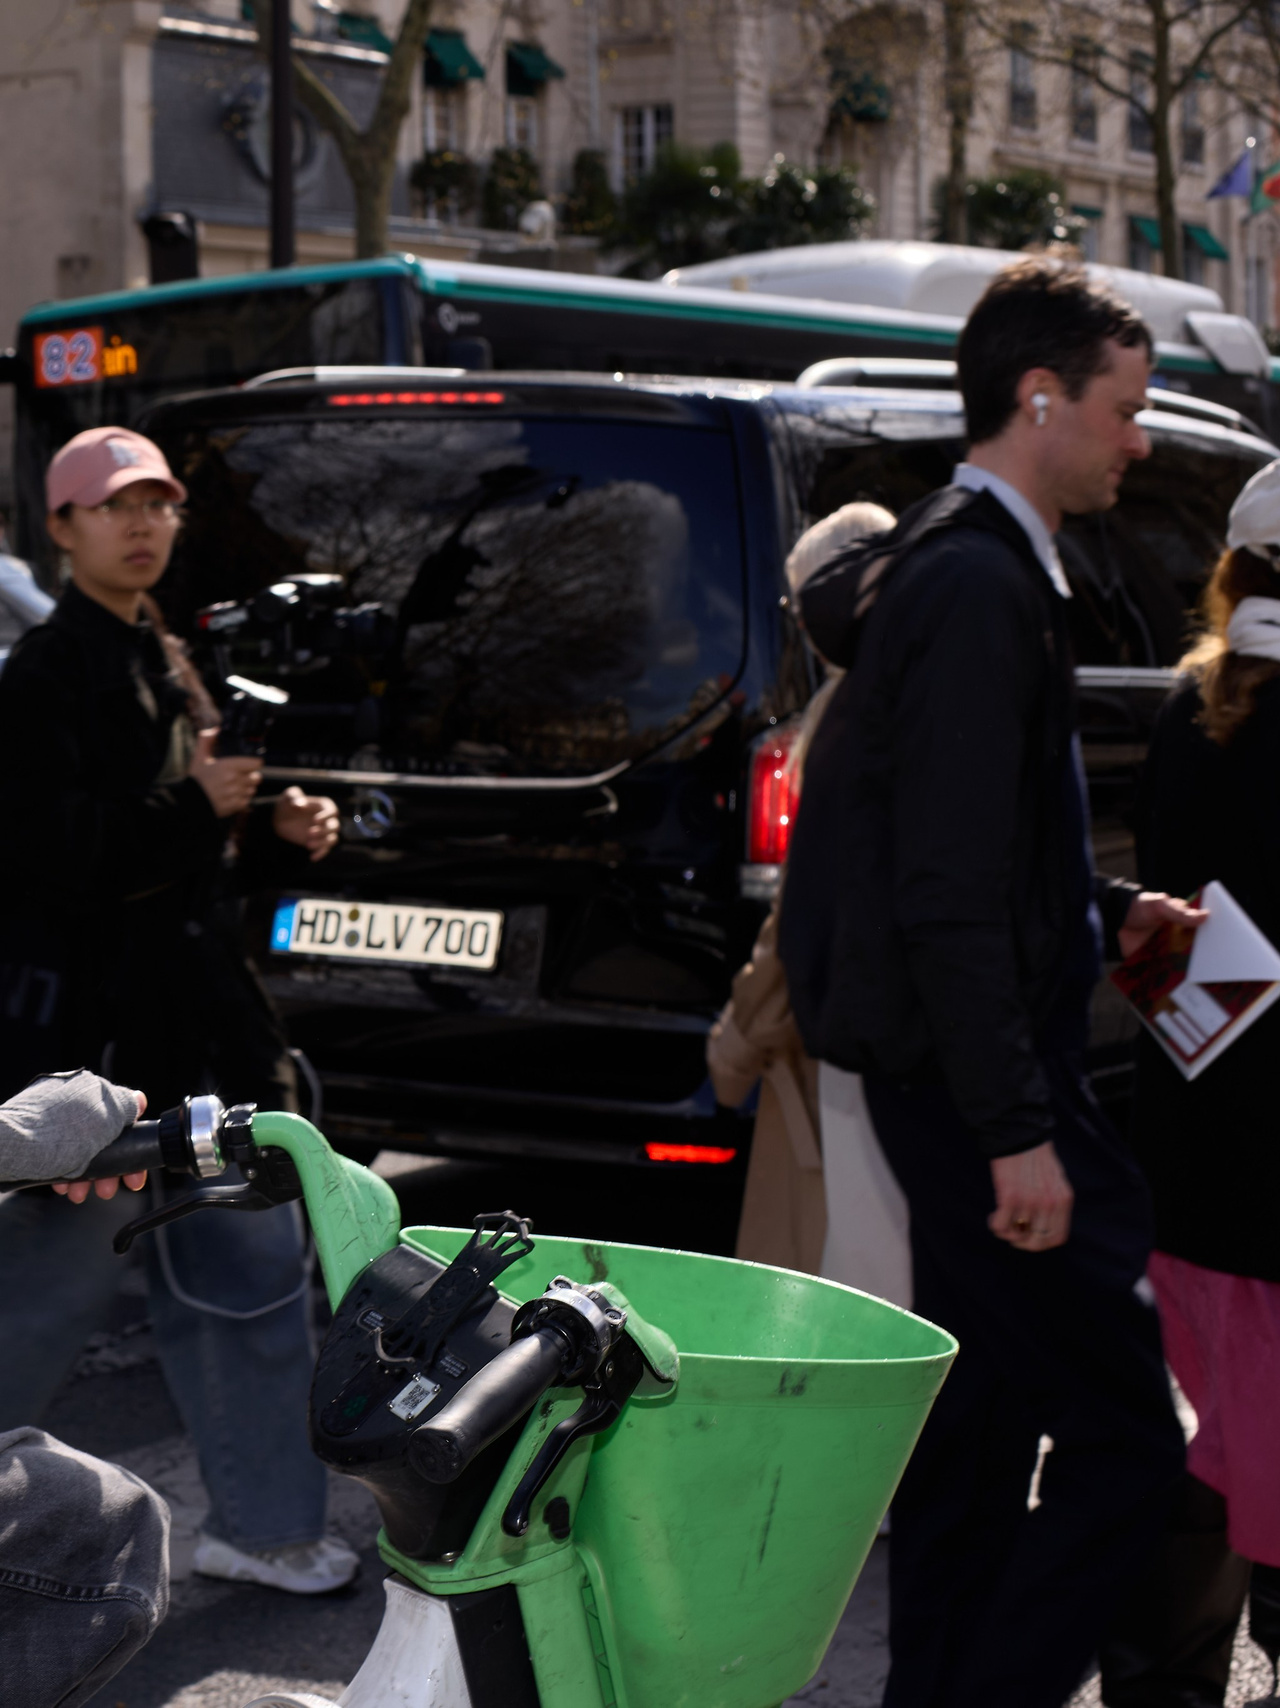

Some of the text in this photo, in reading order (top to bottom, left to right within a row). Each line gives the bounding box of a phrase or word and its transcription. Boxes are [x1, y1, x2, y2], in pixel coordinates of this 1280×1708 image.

[41, 331, 97, 384] 82
[295, 908, 341, 945] HD
[366, 913, 413, 950] LV
[423, 917, 489, 956] 700
